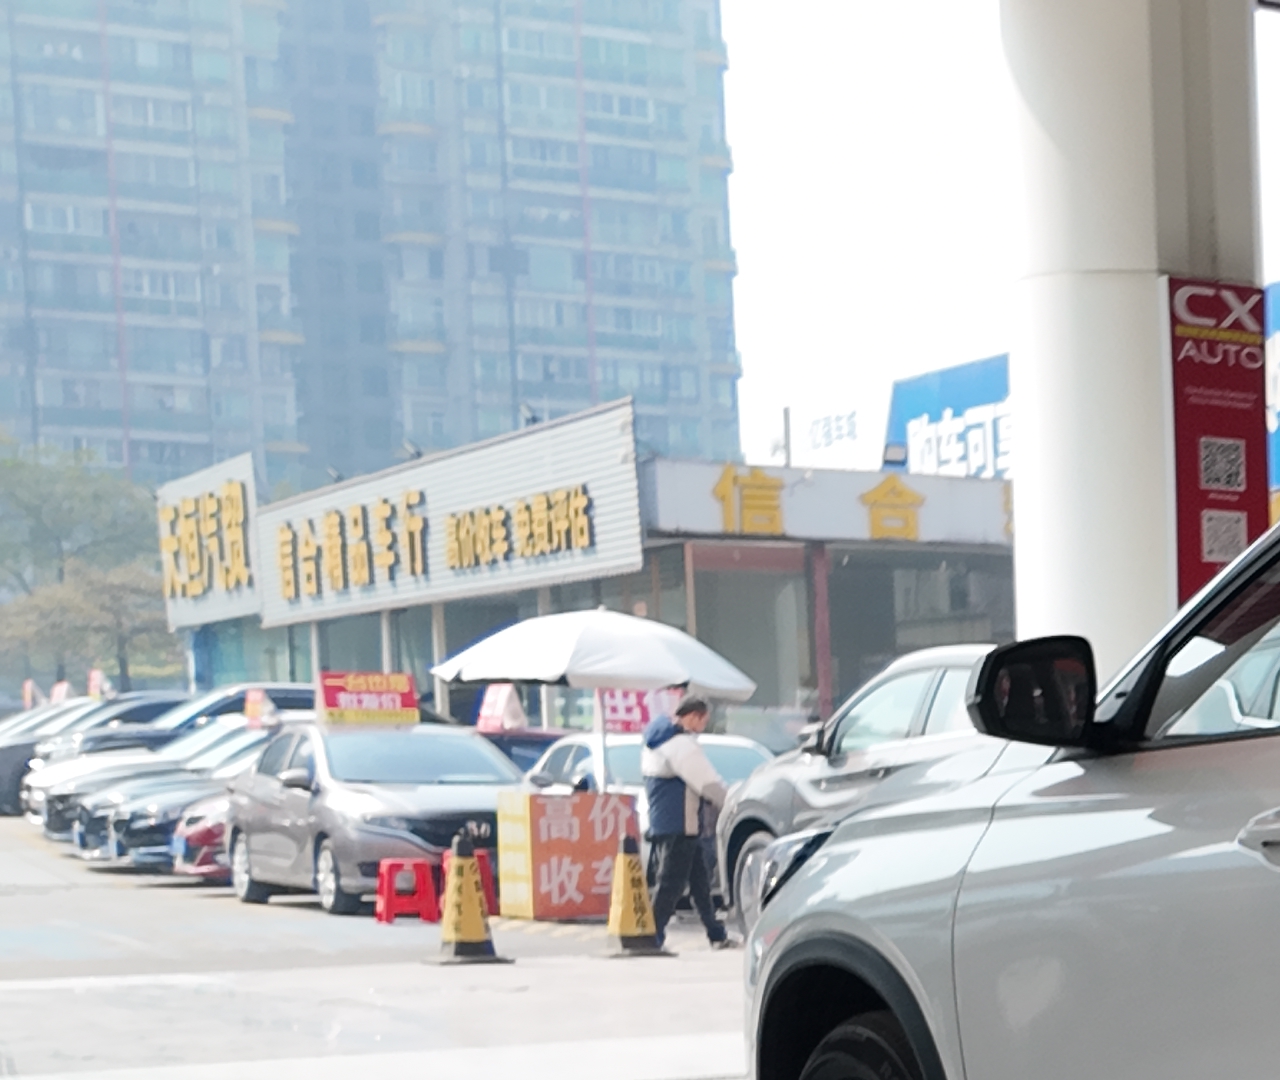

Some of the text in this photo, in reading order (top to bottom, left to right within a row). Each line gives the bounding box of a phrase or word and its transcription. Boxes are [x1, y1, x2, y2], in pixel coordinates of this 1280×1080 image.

[1173, 285, 1262, 332] CX
[1177, 340, 1263, 369] AUTO
[537, 796, 631, 843] 高价
